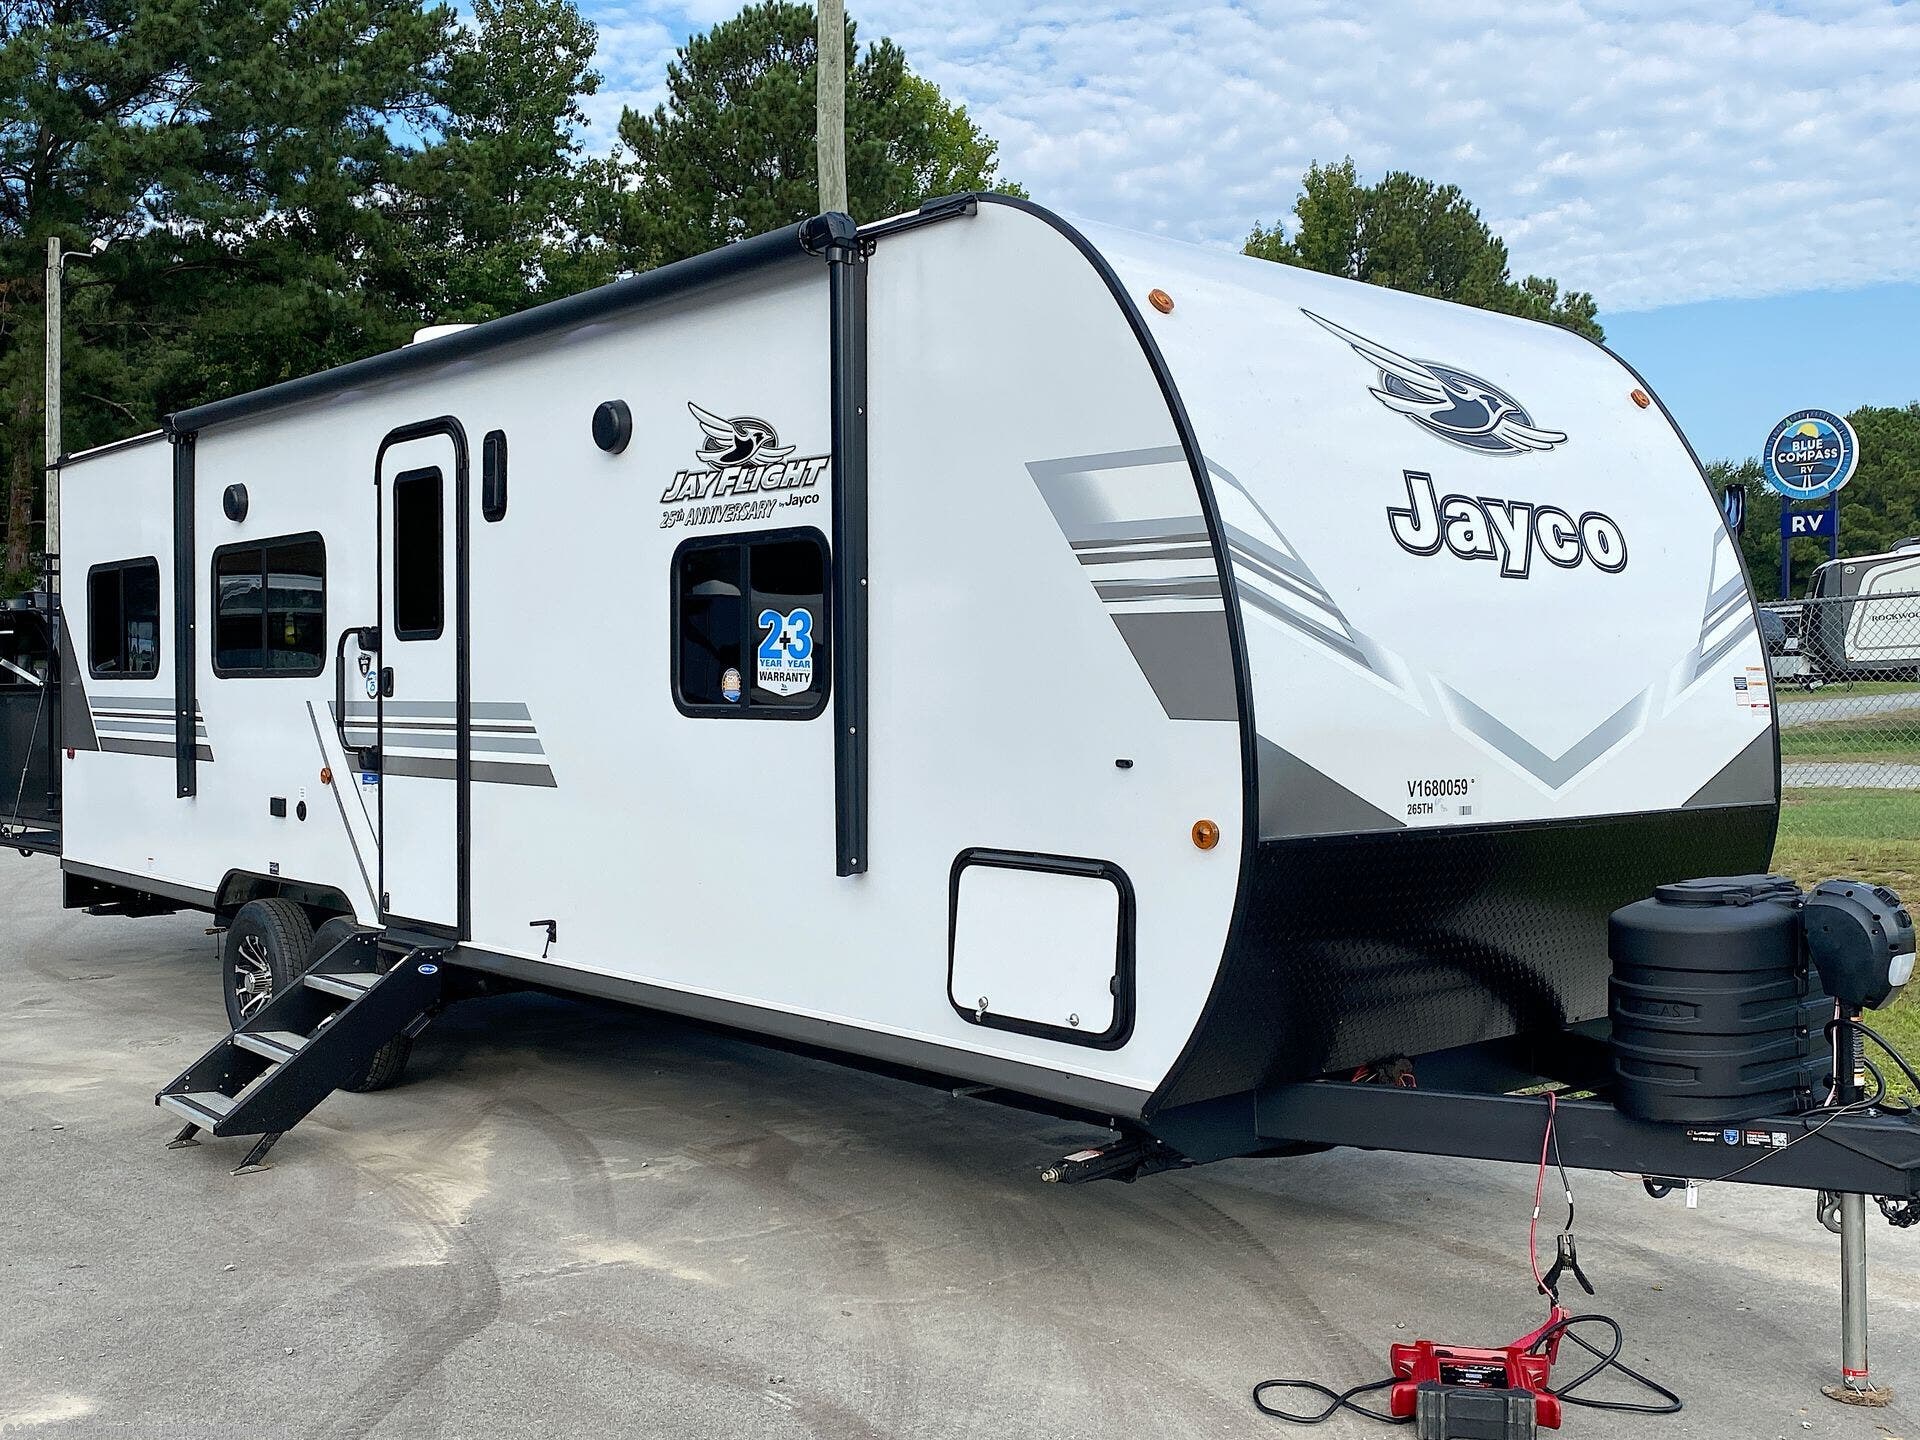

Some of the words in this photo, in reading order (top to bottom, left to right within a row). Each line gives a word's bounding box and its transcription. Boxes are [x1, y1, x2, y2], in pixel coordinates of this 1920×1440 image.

[1792, 439, 1823, 452] BLUE
[1777, 448, 1838, 463] COMPASS
[713, 455, 832, 498] FLIGHT
[1800, 465, 1814, 474] RV
[785, 494, 820, 508] Jayco
[659, 508, 686, 528] 25th
[684, 499, 777, 526] ANNIVERSARY
[1386, 469, 1628, 579] Jayco
[1792, 515, 1823, 532] RV
[760, 659, 782, 668] YEAR
[788, 660, 811, 669] YEAR
[759, 671, 811, 683] WARRANTY
[1407, 802, 1434, 815] 265TH
